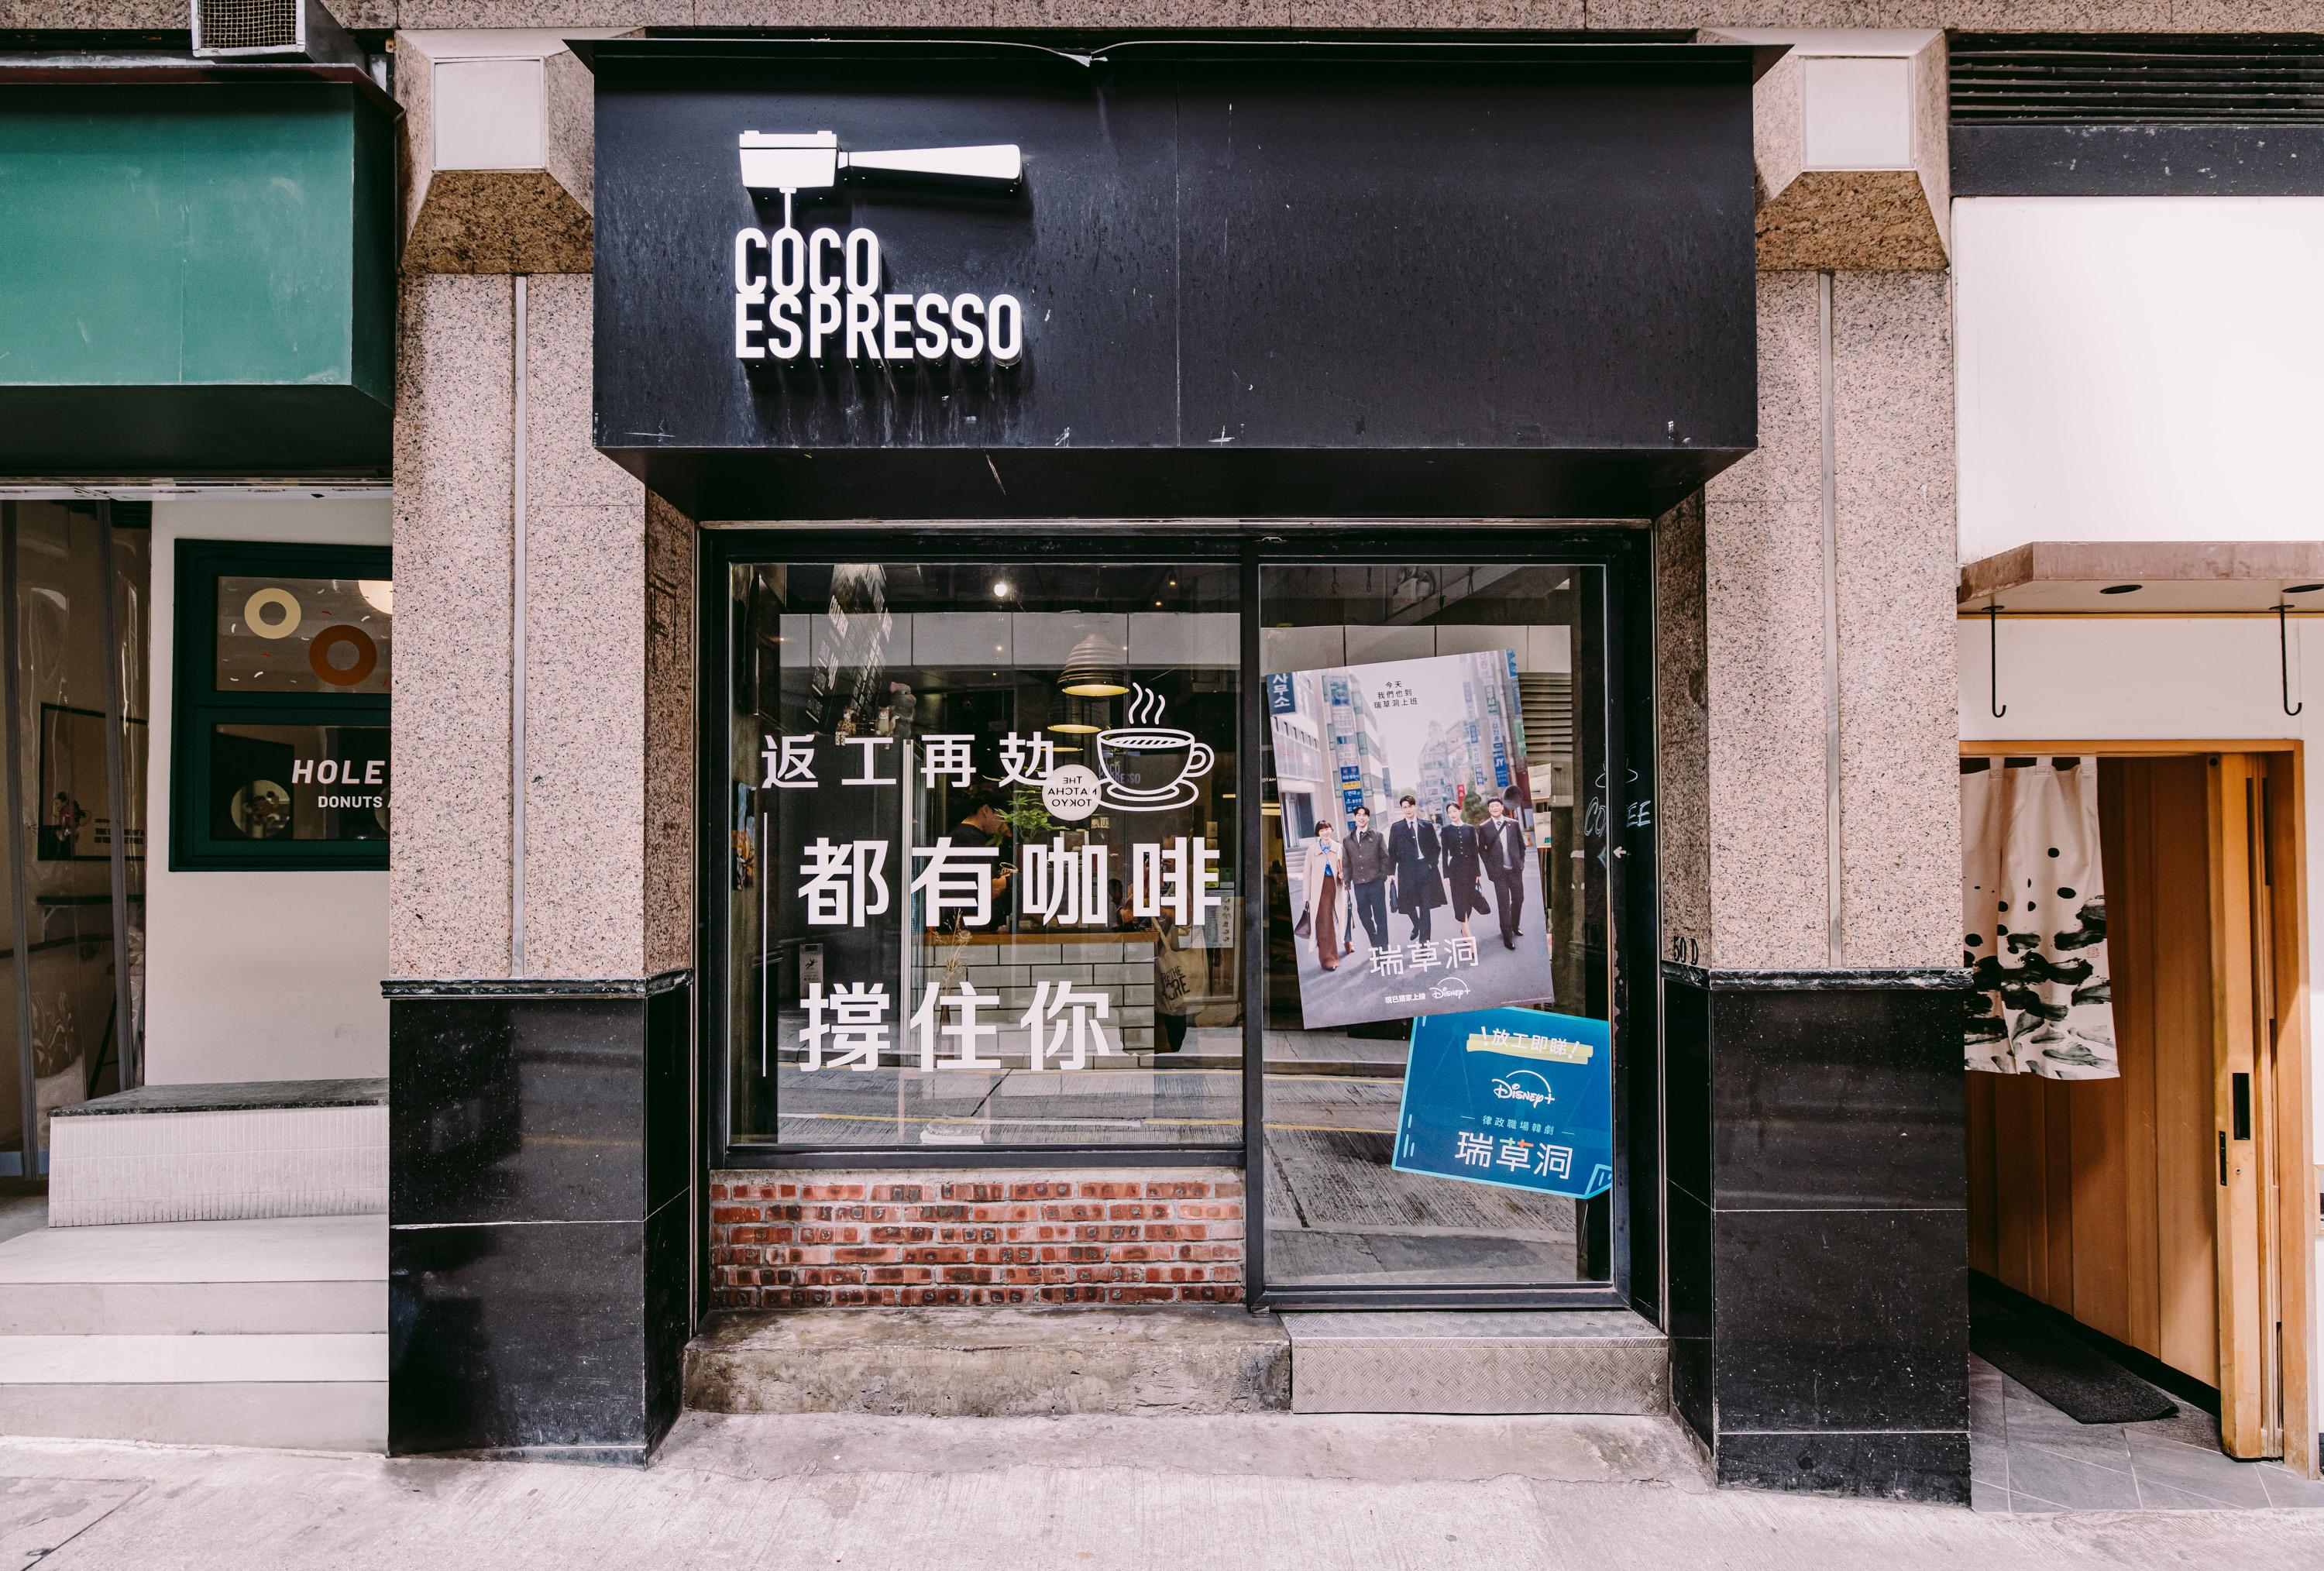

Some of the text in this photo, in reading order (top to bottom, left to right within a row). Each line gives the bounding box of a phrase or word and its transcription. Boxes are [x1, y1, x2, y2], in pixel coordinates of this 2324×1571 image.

[735, 227, 880, 295] COCO
[735, 294, 1023, 360] ESPRESSO
[1273, 673, 1291, 708] 사무소
[1377, 689, 1412, 700] 我們也到
[1385, 680, 1403, 689] 今天
[1373, 697, 1418, 709] 瑞草洞上班
[291, 759, 386, 785] HOLE
[318, 796, 383, 808] DONUTS
[798, 837, 1222, 927] 都有咖啡
[1368, 936, 1479, 977] 瑞草洞
[1673, 935, 1699, 965] 50 D
[799, 981, 1111, 1072] 撐住你
[1482, 1114, 1555, 1136] 律政職場韓劇
[1454, 1131, 1573, 1180] 瑞草洞
